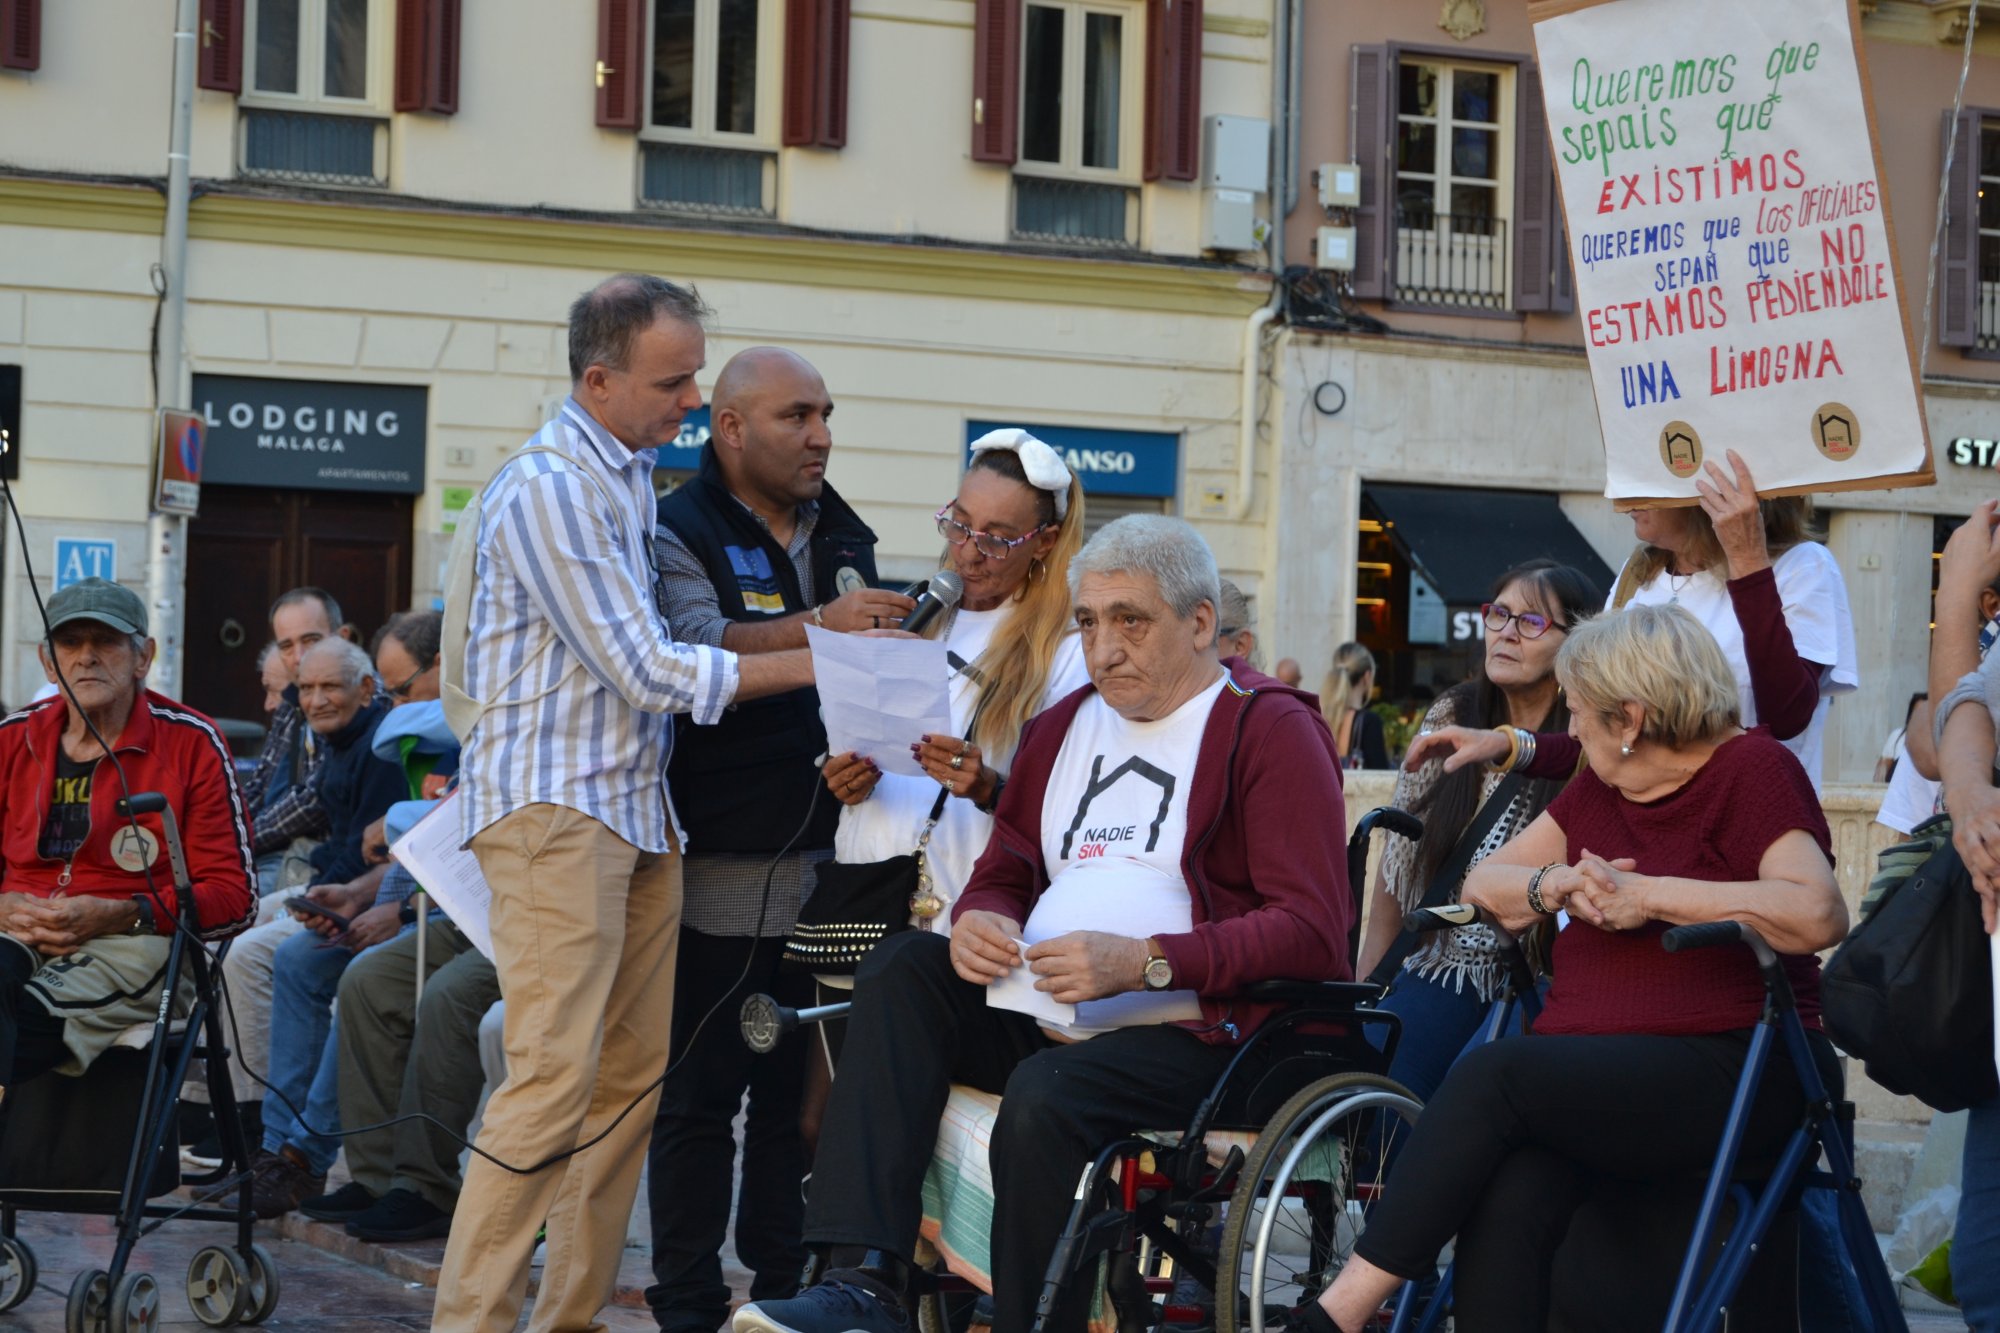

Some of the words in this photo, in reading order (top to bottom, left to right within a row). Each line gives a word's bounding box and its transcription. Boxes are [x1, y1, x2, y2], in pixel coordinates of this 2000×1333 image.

[1572, 54, 1737, 115] Queremos
[1766, 38, 1820, 104] que
[1562, 103, 1677, 178] sepais
[1582, 222, 1685, 272] QUEREMOS
[1703, 216, 1741, 258] que
[1748, 238, 1790, 285] que
[1820, 223, 1865, 268] NO
[1587, 285, 1727, 347] ESTAMOS
[1620, 360, 1682, 409] UNA
[1710, 338, 1844, 396] LIMOSNA
[203, 401, 400, 437] LODGING
[257, 434, 346, 453] MALAGA
[61, 545, 110, 579] AT
[1078, 843, 1108, 860] SIN
[1084, 825, 1136, 842] NADIE
